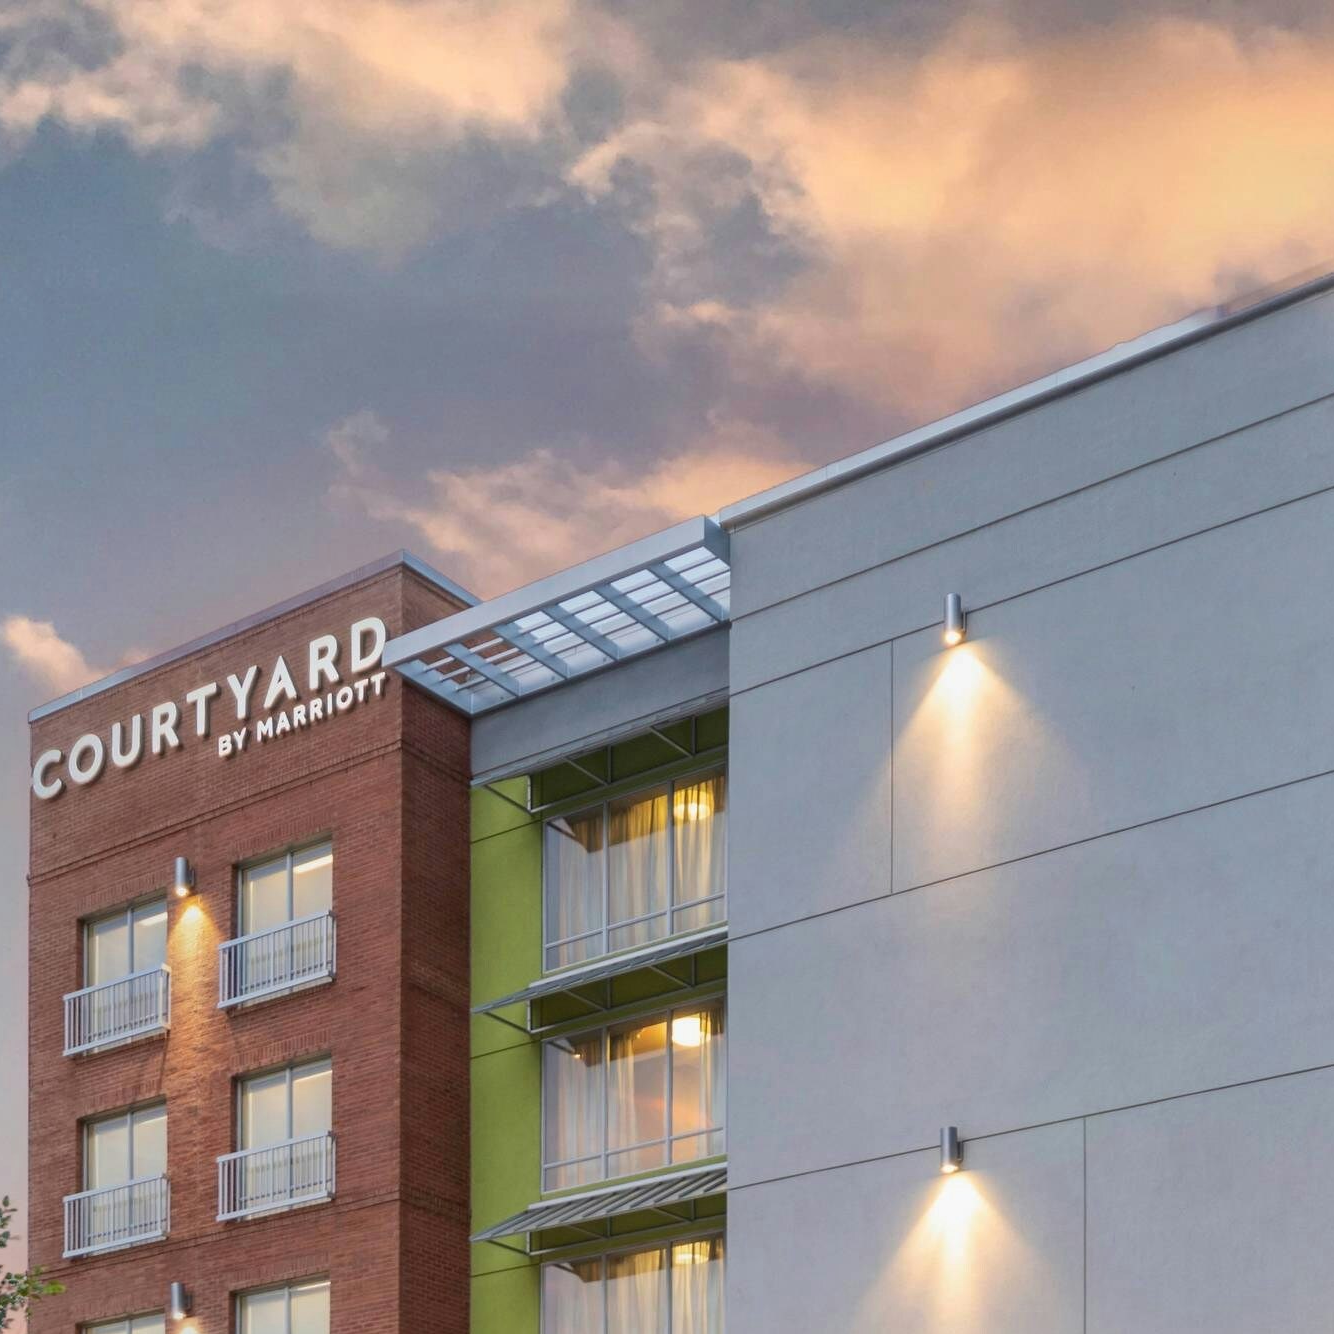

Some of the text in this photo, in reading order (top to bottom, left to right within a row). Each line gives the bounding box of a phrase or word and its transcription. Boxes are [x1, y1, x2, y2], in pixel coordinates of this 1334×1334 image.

[32, 617, 387, 800] COURTYARD
[218, 671, 387, 758] BY MARRIOTT
